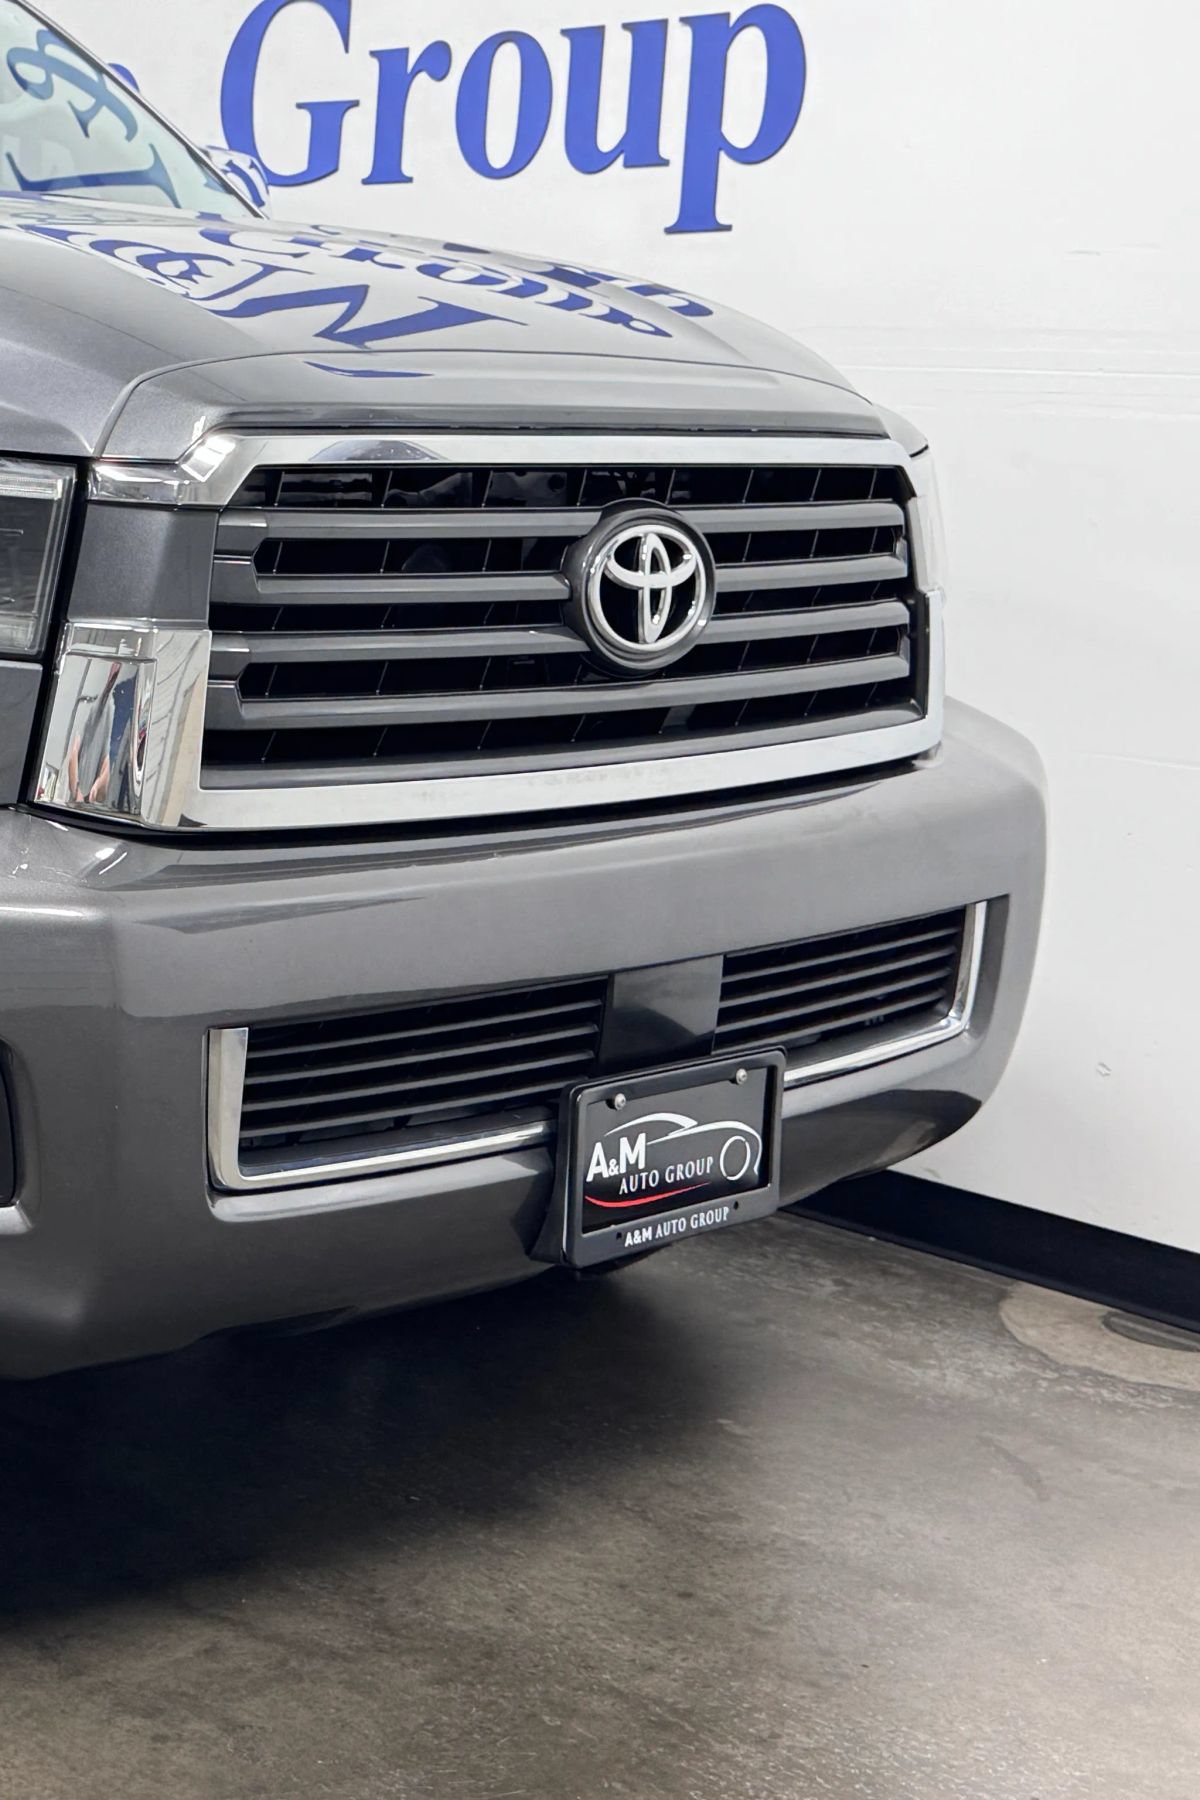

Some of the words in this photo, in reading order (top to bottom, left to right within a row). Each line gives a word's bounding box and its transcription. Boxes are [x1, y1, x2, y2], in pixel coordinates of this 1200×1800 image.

[219, 0, 807, 235] Group
[586, 1133, 646, 1182] A&M
[619, 1170, 659, 1195] AUTO
[665, 1157, 714, 1183] GROUP
[624, 1228, 652, 1247] A&M
[655, 1217, 686, 1239] AUTO
[690, 1207, 729, 1229] GROUP
